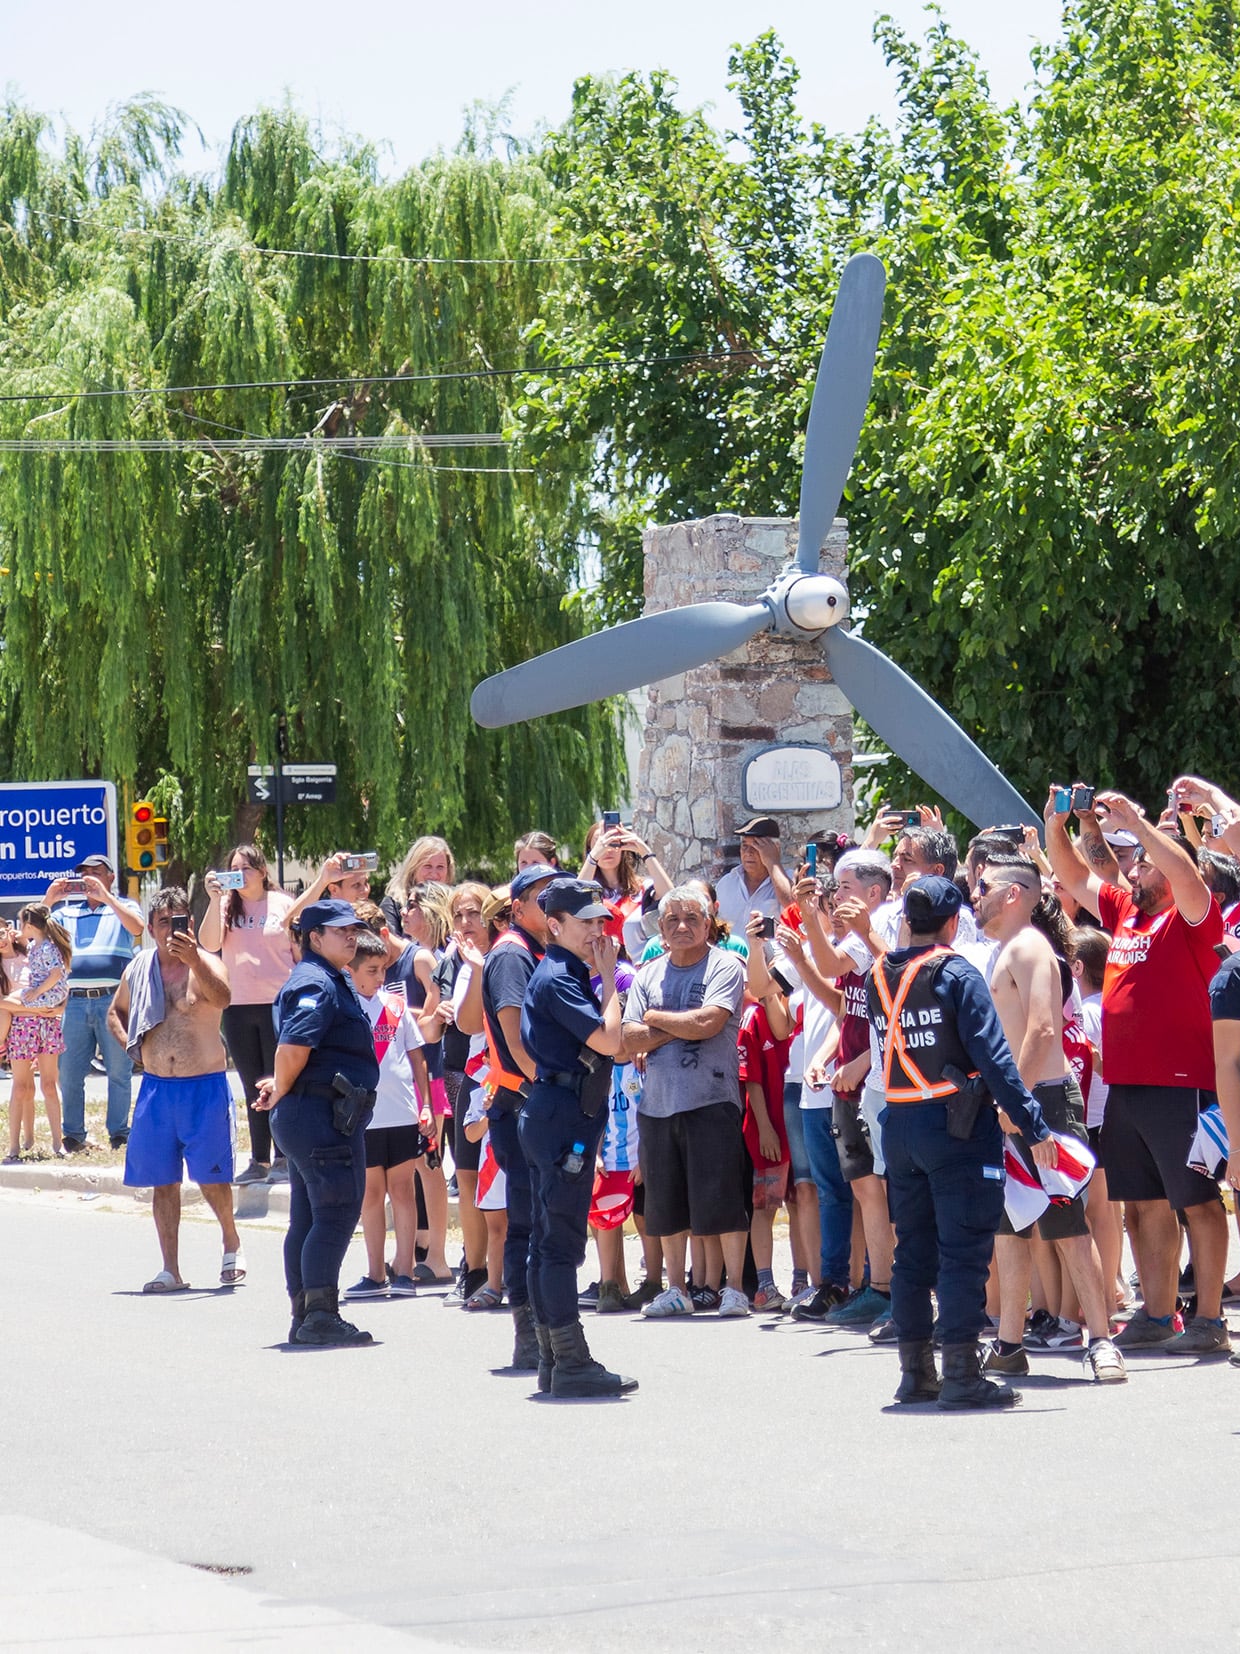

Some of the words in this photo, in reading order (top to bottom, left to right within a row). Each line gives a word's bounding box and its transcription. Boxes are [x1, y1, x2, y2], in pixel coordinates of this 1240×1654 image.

[0, 804, 106, 832] ropuerto
[0, 841, 16, 860] n
[25, 834, 76, 859] Luis
[0, 871, 37, 881] ropuertos
[918, 1008, 943, 1026] DE
[903, 1031, 937, 1049] UIS
[611, 1091, 630, 1112] 10
